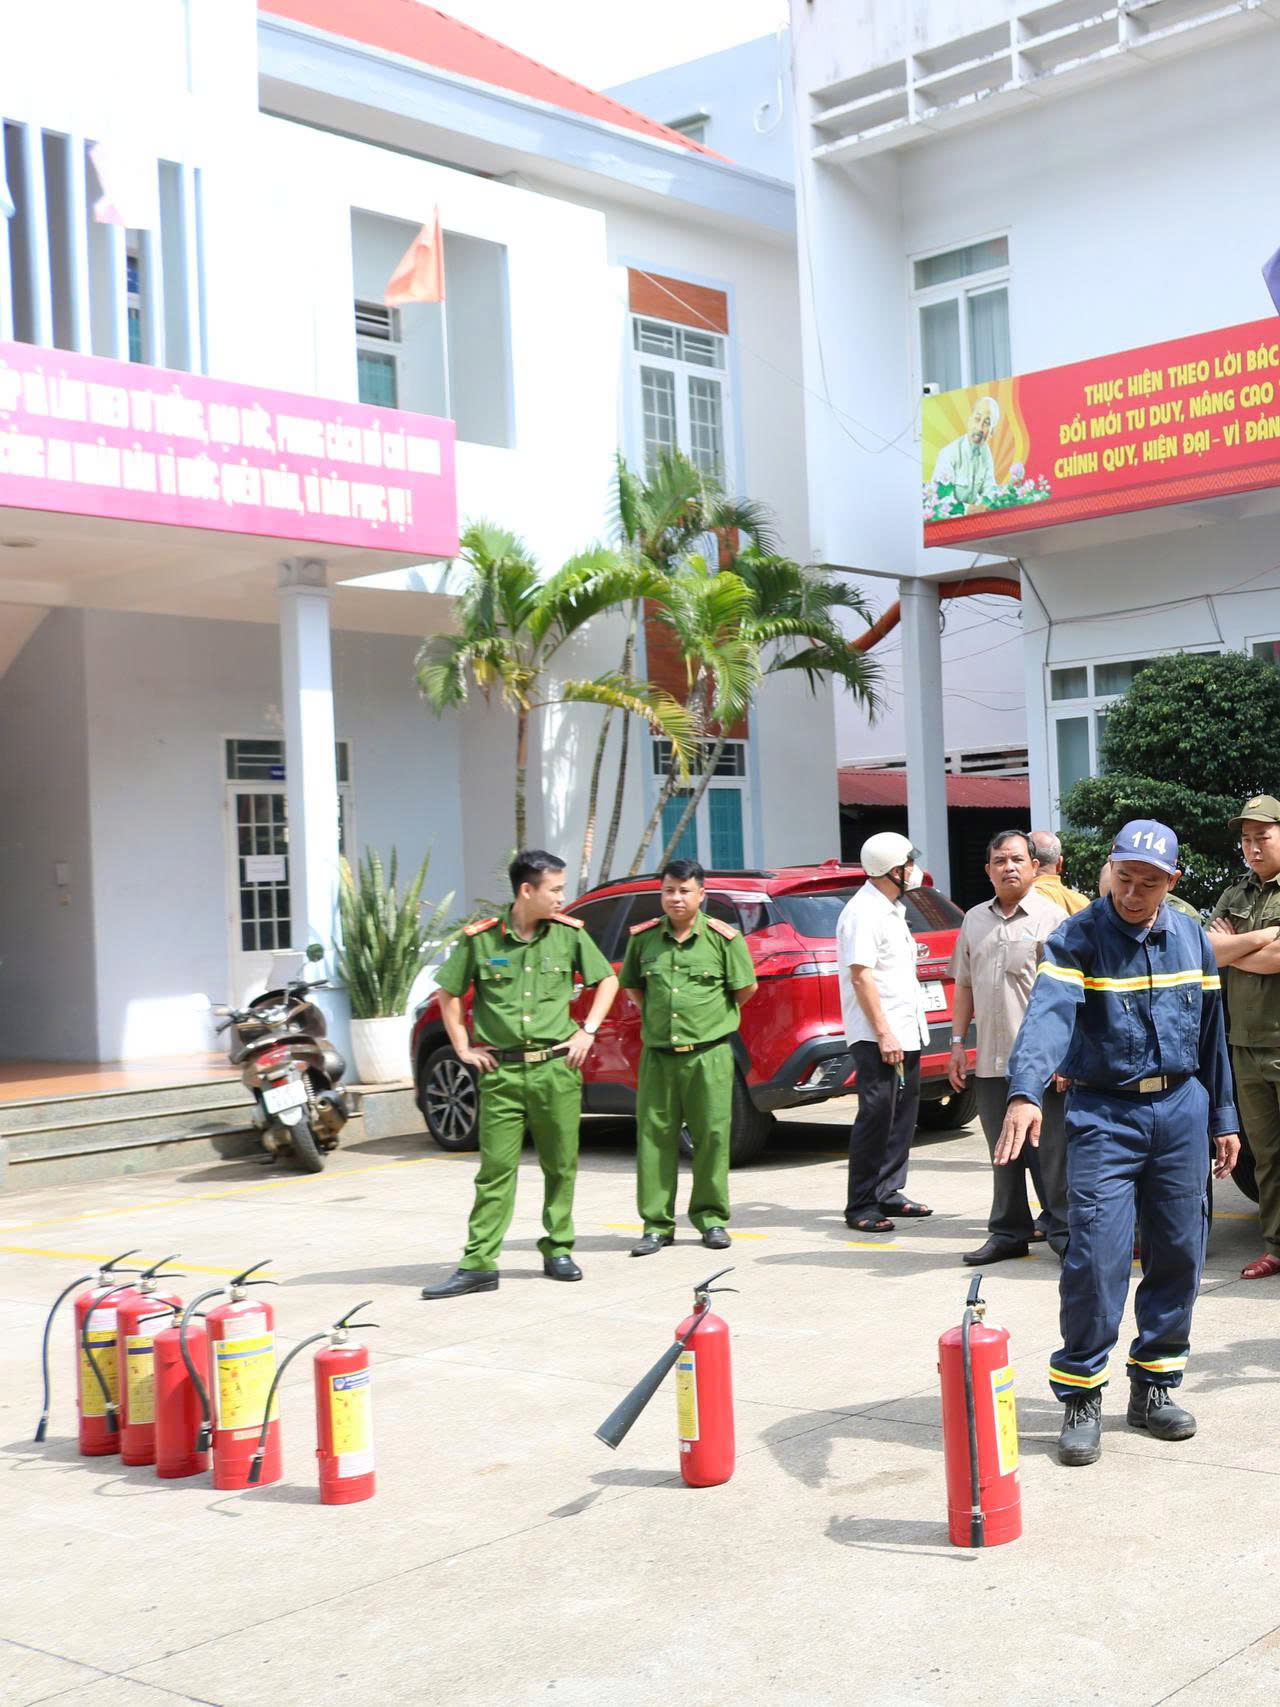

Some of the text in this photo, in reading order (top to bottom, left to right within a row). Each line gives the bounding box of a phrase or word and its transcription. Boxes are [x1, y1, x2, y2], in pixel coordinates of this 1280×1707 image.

[1128, 368, 1163, 397] HIỆN
[1168, 359, 1210, 388] THEO
[1214, 350, 1242, 378] LỜI
[1246, 342, 1280, 372] BÁC
[1059, 412, 1086, 445] ĐỔI
[1090, 412, 1121, 439] MỚI
[1149, 400, 1184, 427] DUY,
[1189, 389, 1235, 418] NÂNG
[1239, 381, 1274, 408] CAO
[1054, 451, 1098, 479] CHÍNH
[1102, 443, 1138, 472] QUY,
[1142, 431, 1178, 464] HIỆN
[1182, 428, 1210, 457] ĐẠI
[1223, 418, 1240, 446] VÌ
[1132, 831, 1167, 855] 114
